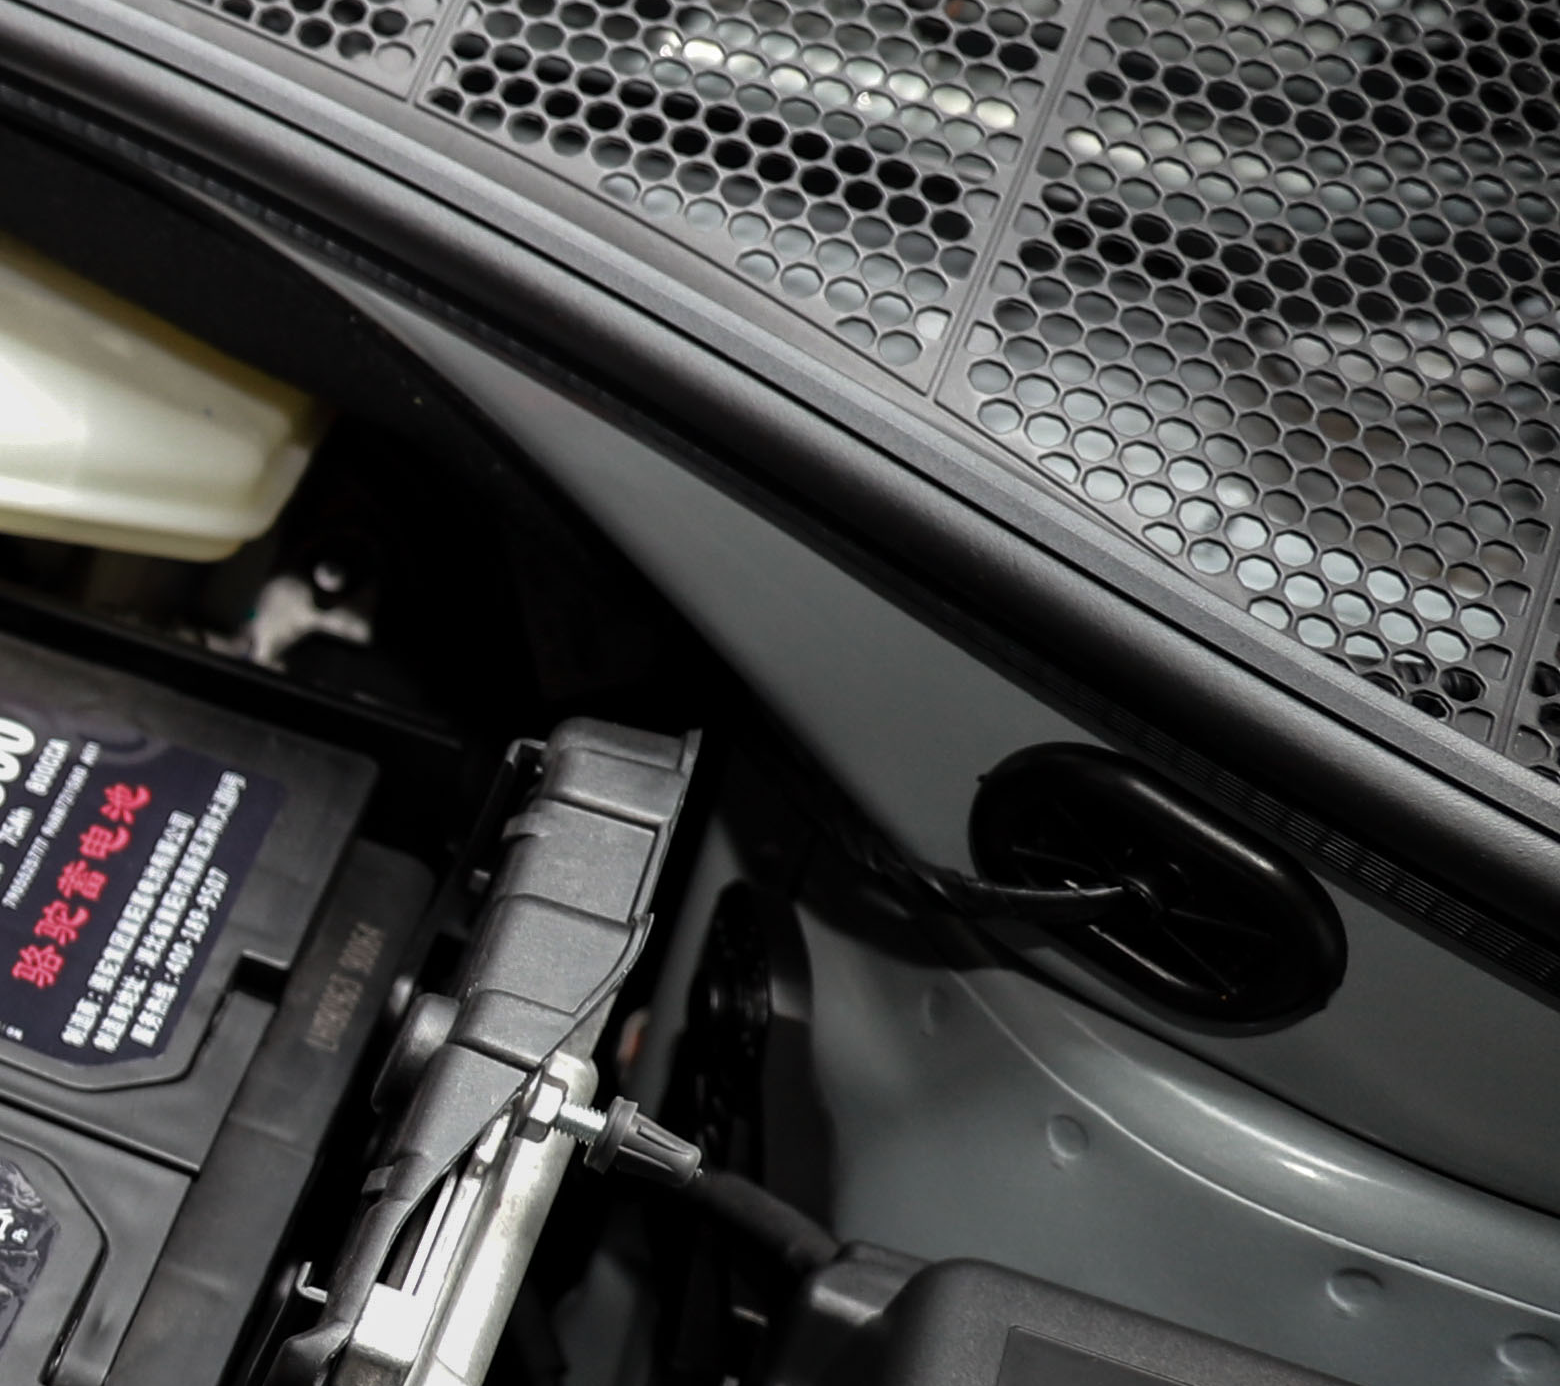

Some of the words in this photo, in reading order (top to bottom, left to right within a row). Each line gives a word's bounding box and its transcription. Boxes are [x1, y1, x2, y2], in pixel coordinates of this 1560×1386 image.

[25, 738, 70, 796] 800CCA
[12, 784, 150, 988] 骆驼蓄电池
